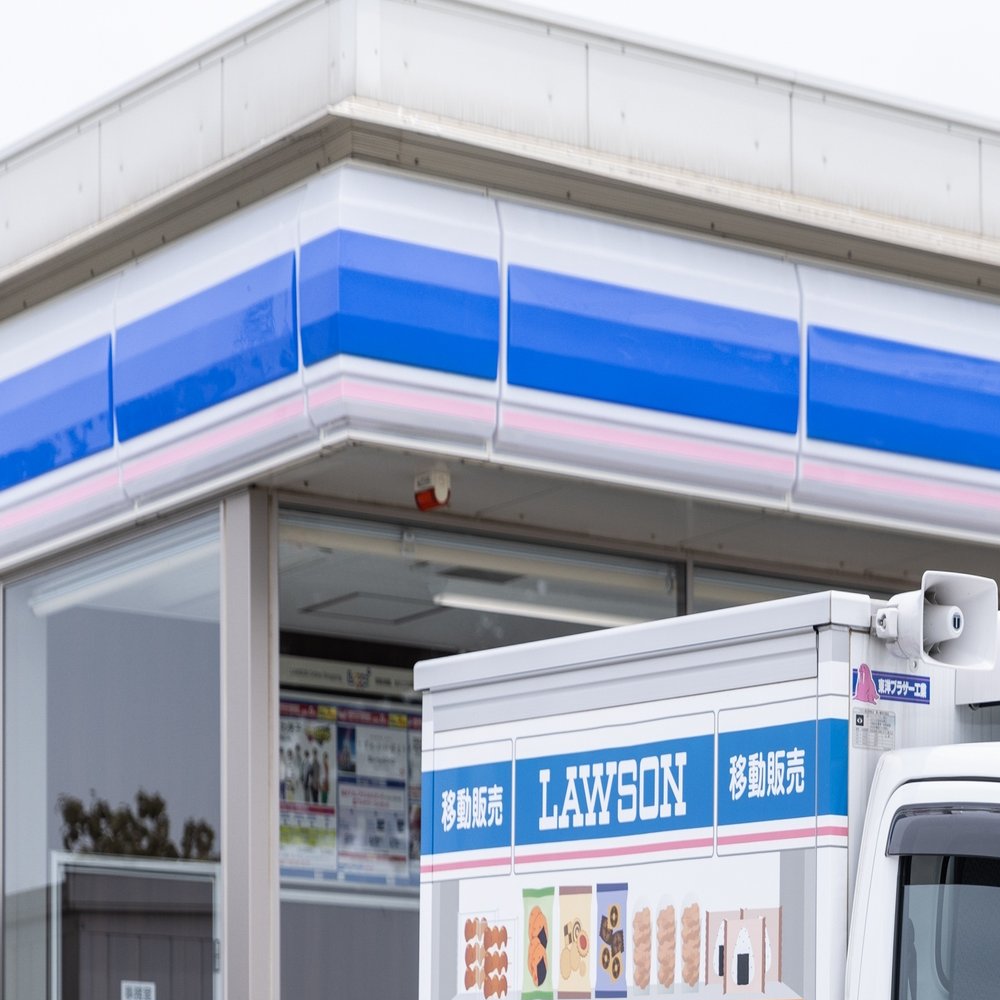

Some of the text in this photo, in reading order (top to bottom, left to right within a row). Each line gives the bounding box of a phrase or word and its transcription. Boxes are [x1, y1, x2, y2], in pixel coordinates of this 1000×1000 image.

[539, 752, 687, 831] LAWSON
[729, 747, 805, 800] 移動販売
[441, 784, 503, 832] 移動販売
